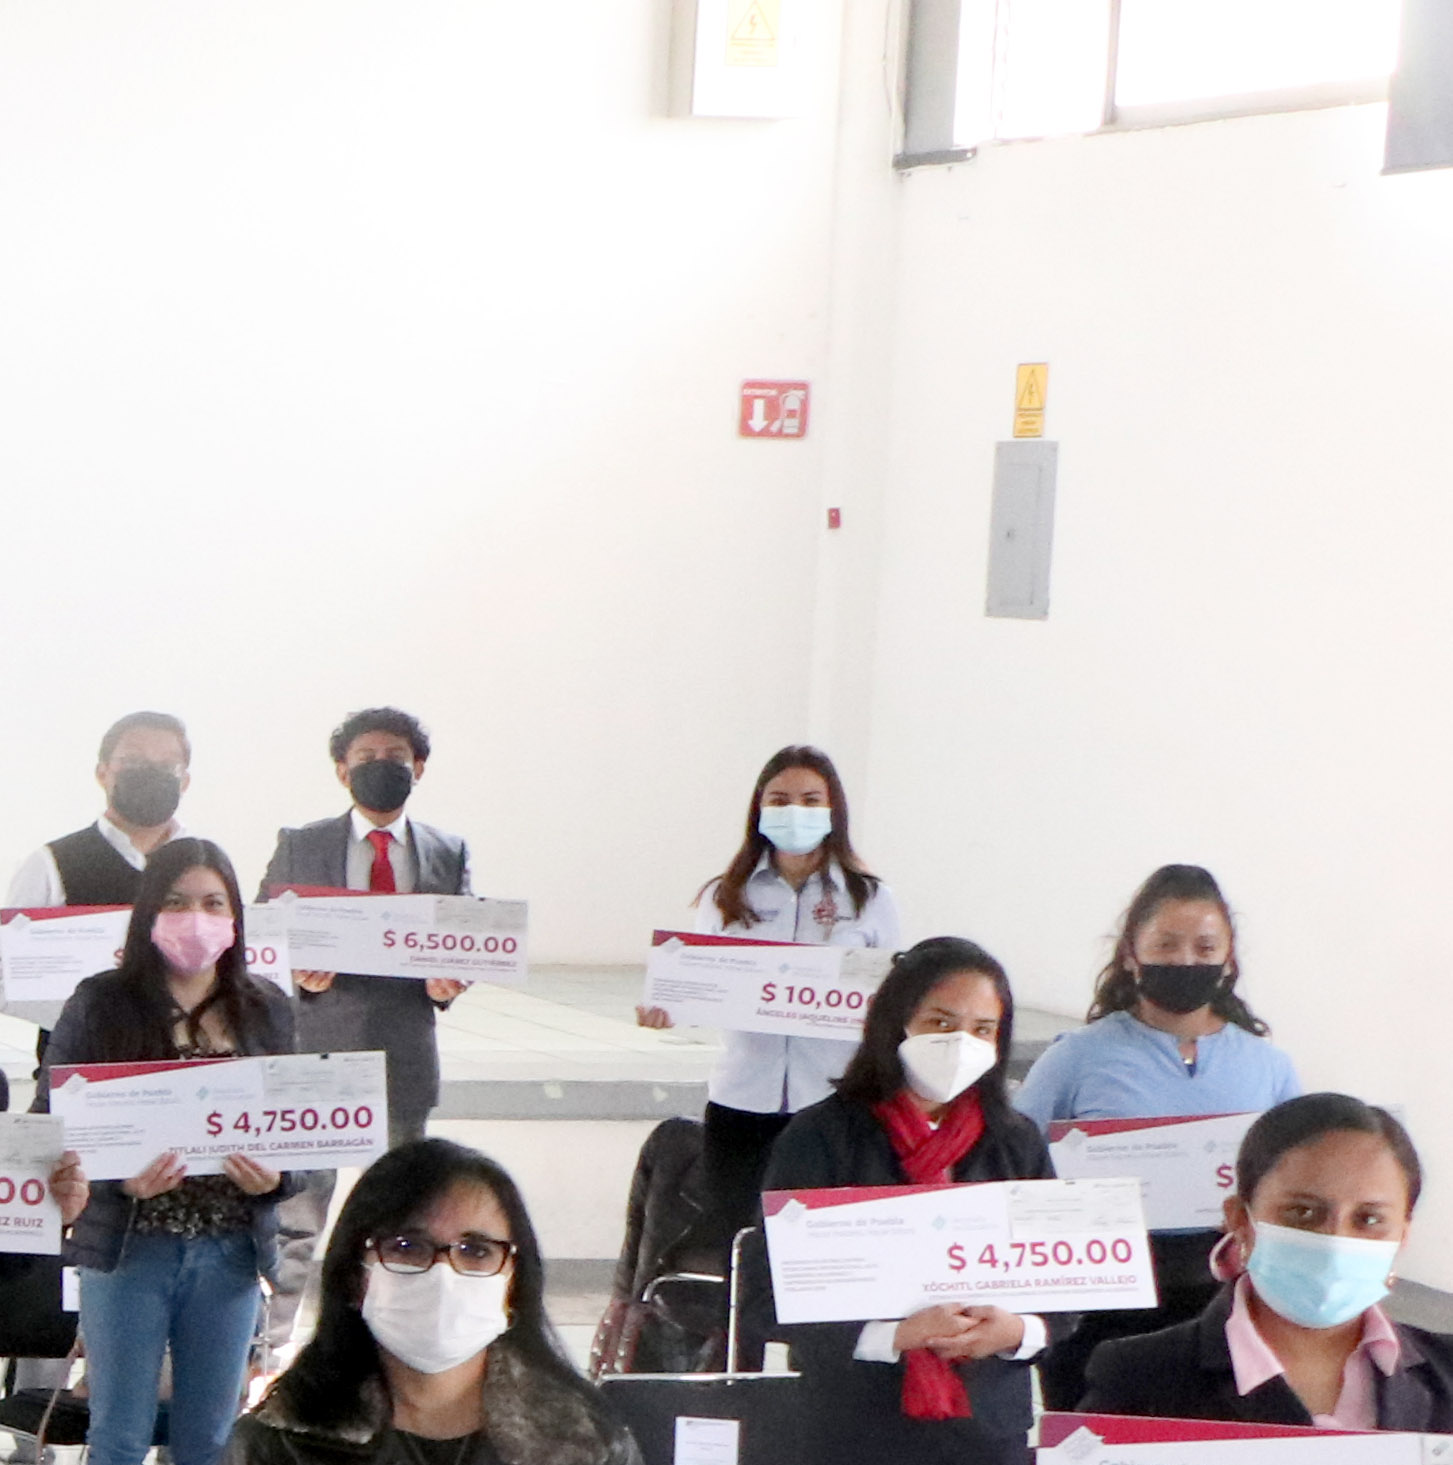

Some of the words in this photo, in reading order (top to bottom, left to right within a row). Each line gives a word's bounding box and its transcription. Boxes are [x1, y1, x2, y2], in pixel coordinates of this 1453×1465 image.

[383, 929, 397, 949] $
[404, 932, 517, 954] 6,500.00
[761, 982, 776, 1003] $
[206, 1110, 223, 1137] $
[233, 1106, 374, 1136] 4,750.00
[1216, 1162, 1234, 1189] $
[947, 1242, 968, 1273] $
[978, 1237, 1133, 1273] 4,750.00
[975, 1277, 1033, 1290] GABRIELA
[1035, 1273, 1087, 1287] RAMÍREZ
